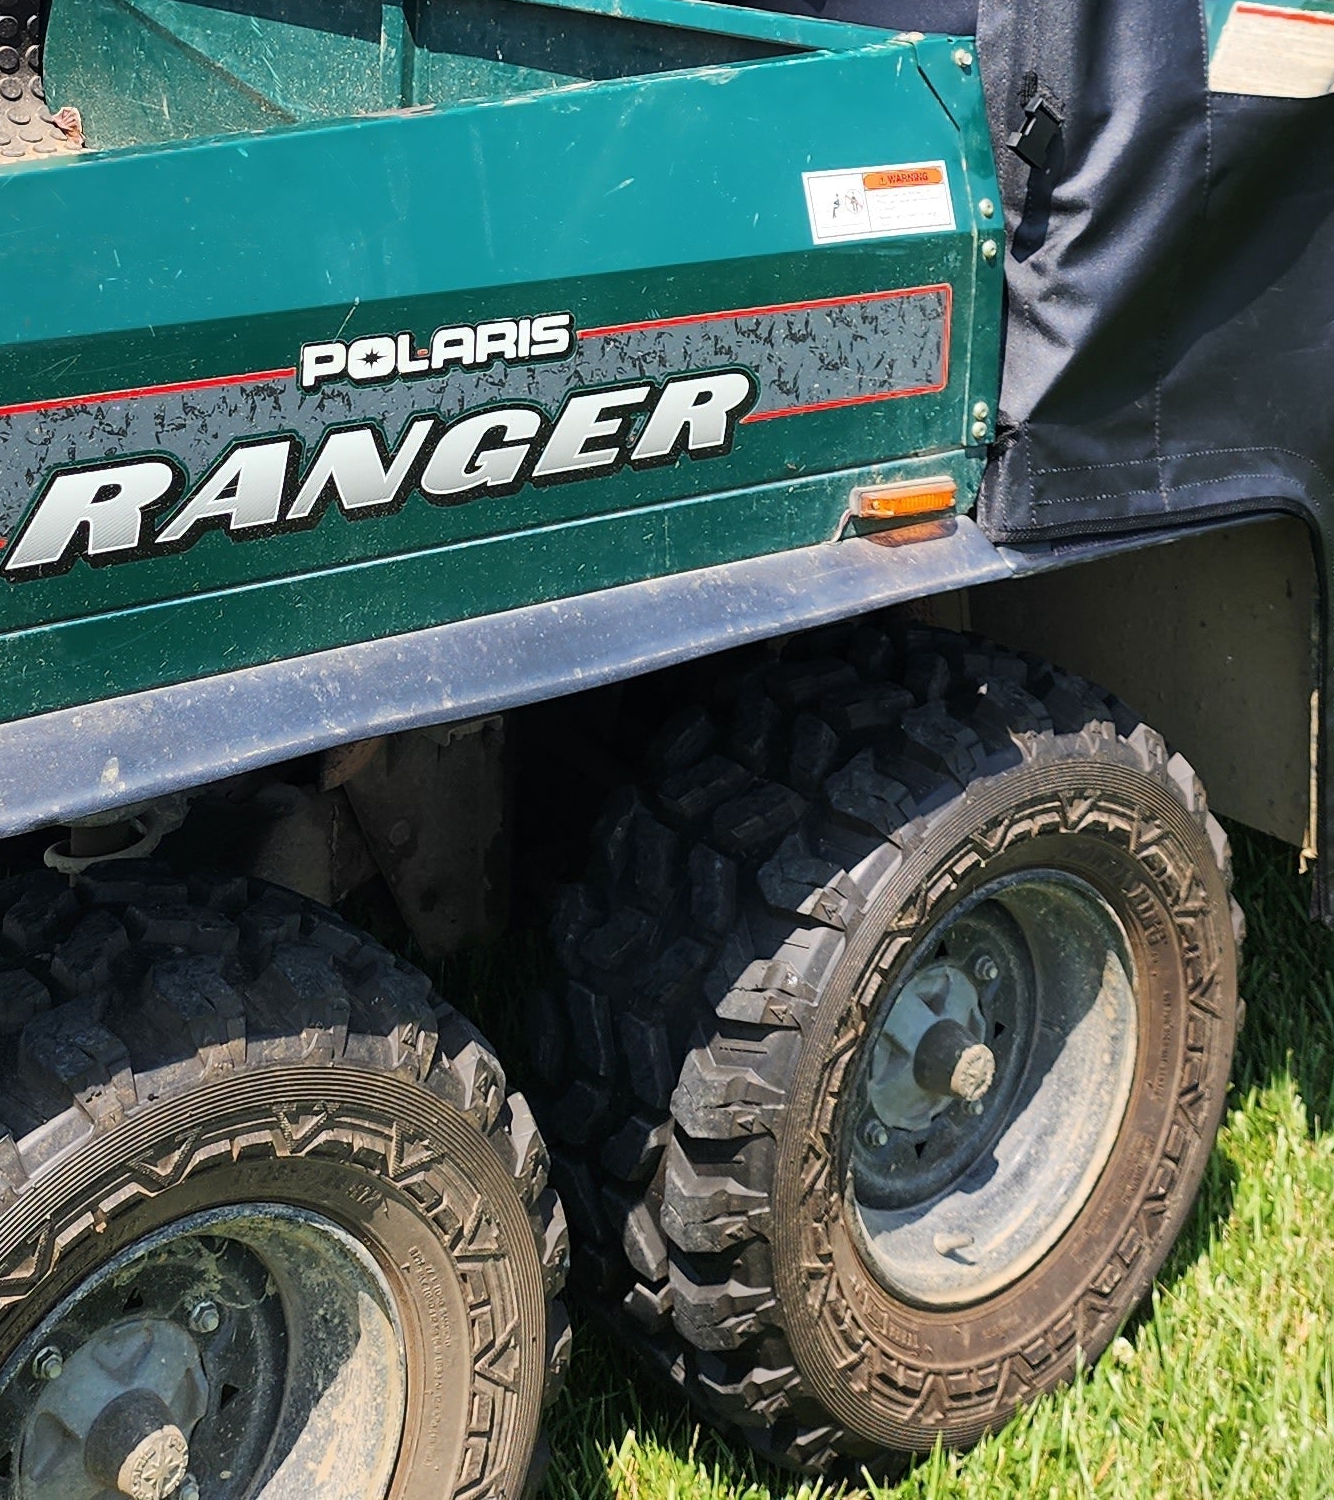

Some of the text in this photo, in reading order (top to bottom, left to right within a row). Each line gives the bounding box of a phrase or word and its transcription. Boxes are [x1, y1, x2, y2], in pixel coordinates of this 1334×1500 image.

[887, 171, 929, 184] WARNING
[300, 314, 573, 387] POLARIS
[5, 372, 752, 571] RANGER
